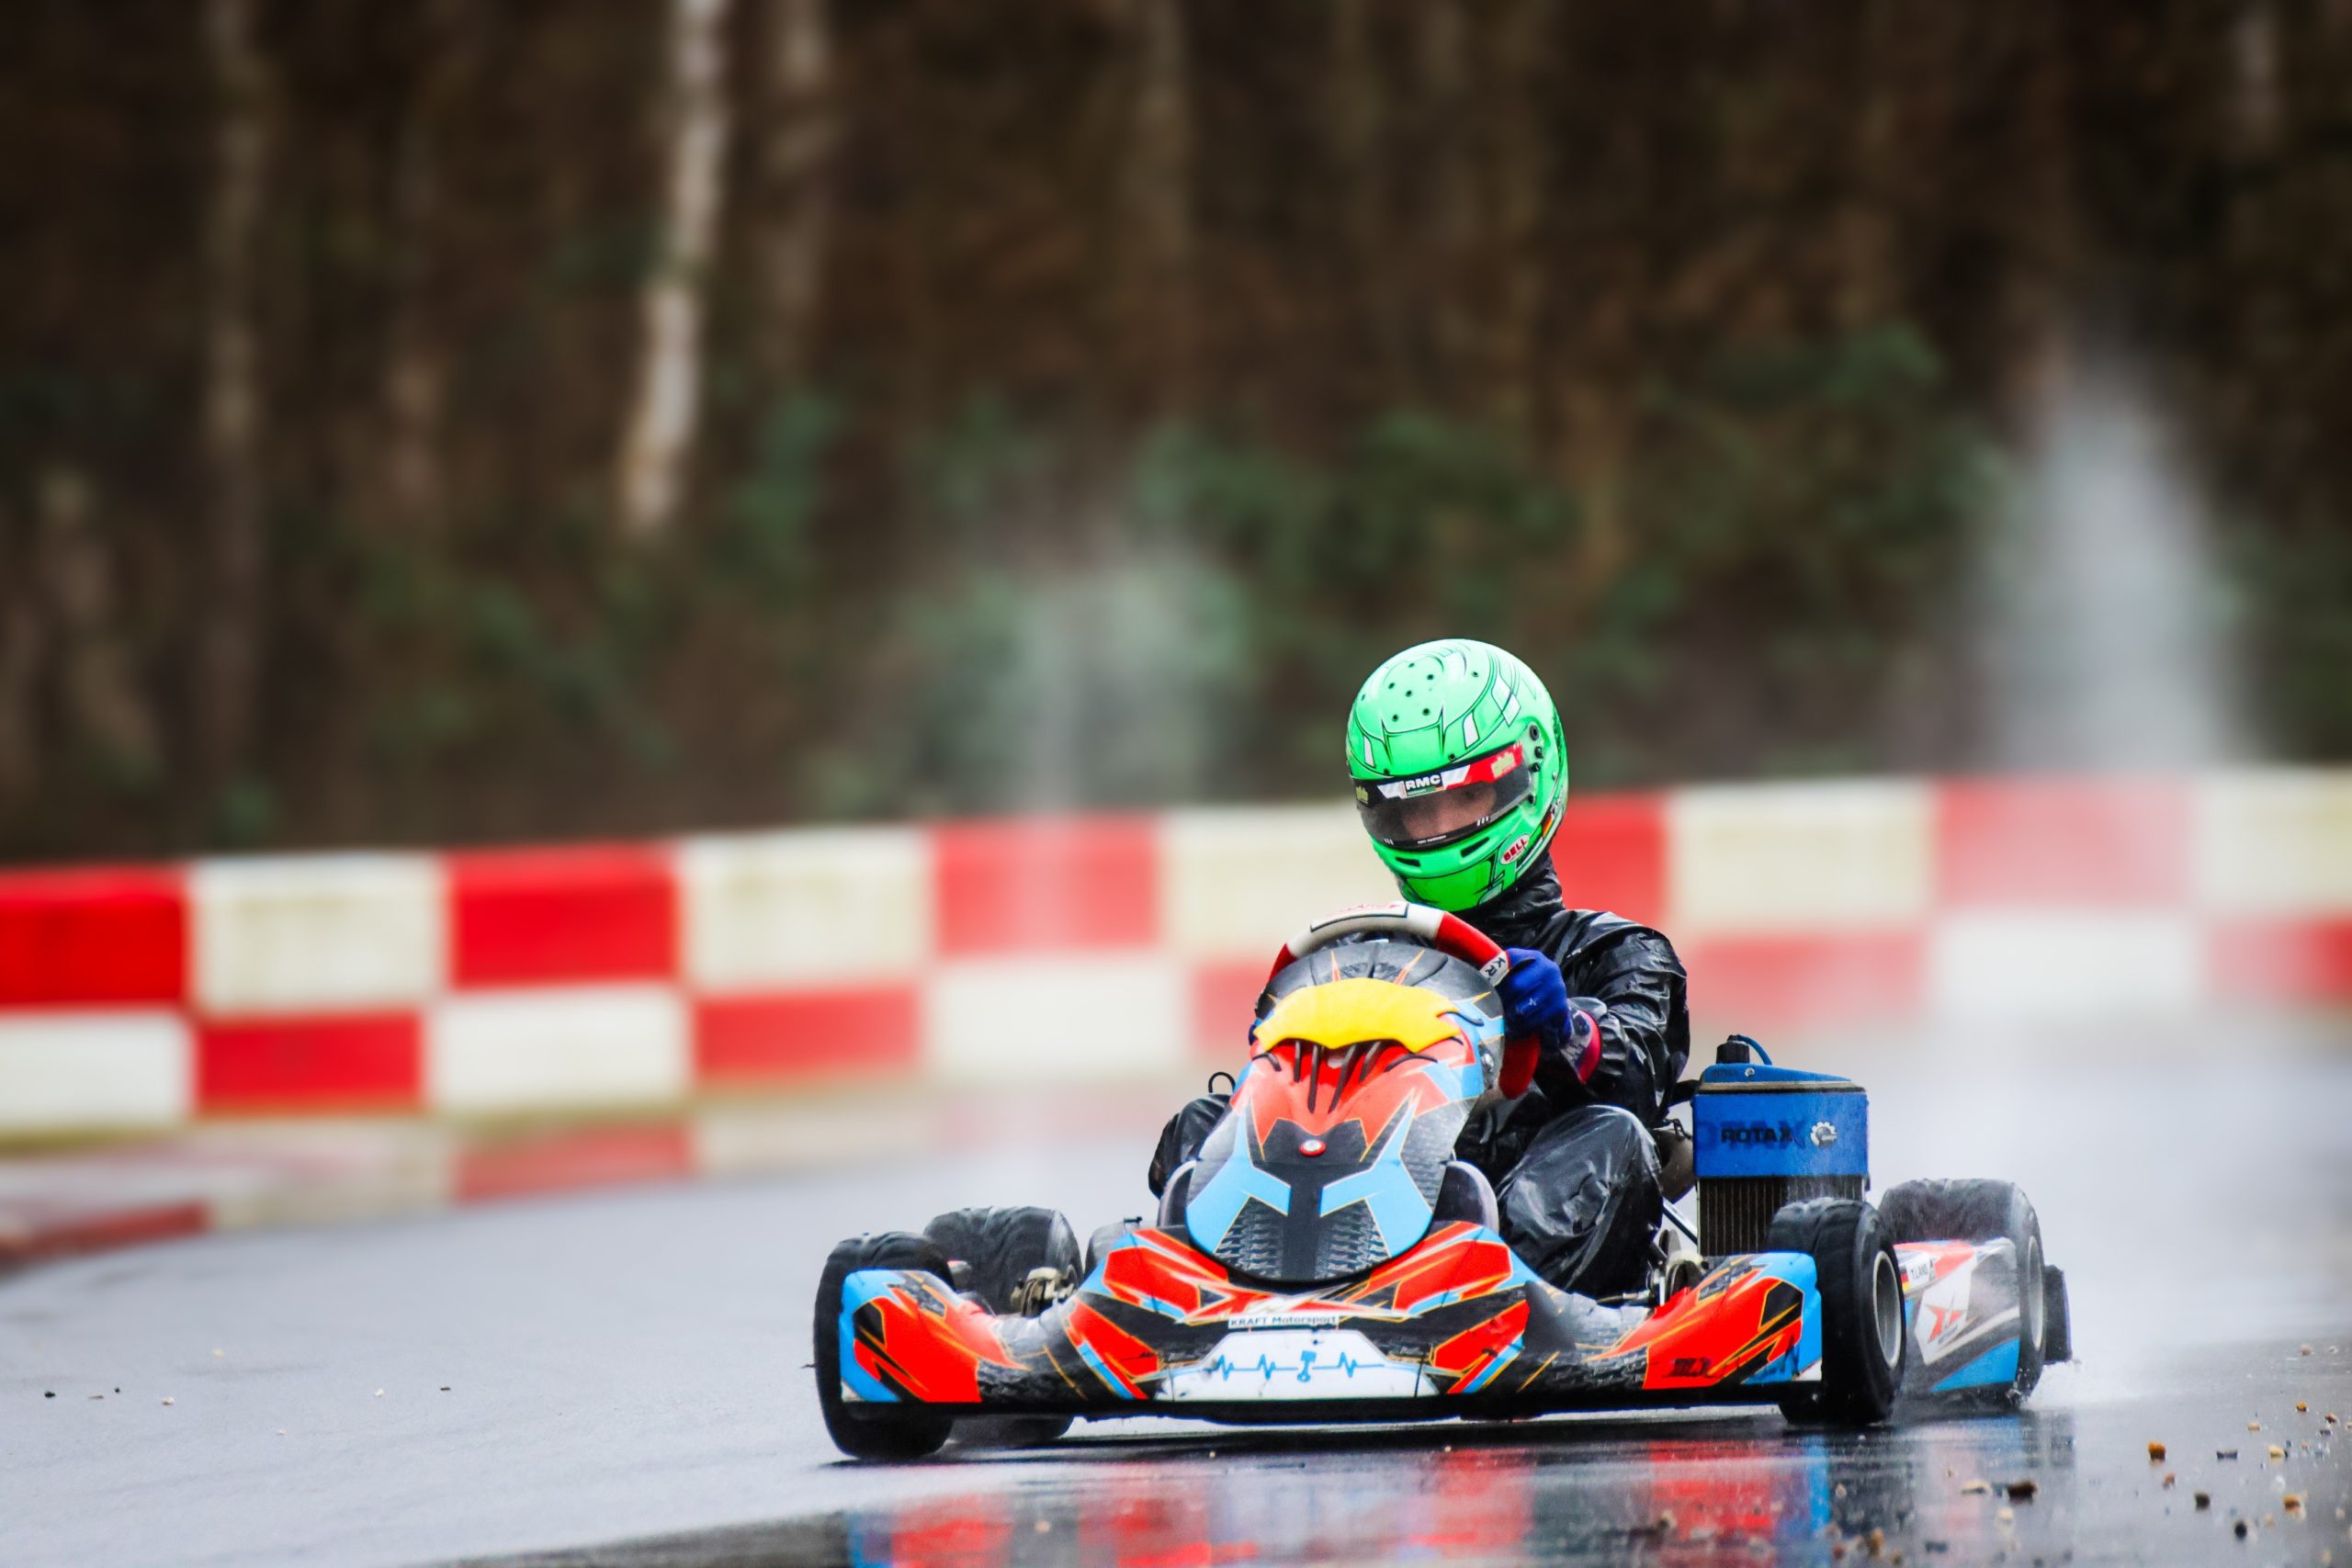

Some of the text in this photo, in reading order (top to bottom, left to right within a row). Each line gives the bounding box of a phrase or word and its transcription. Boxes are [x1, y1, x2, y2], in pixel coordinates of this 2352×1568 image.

[1406, 775, 1442, 790] RMC
[1504, 839, 1526, 862] BELL
[1485, 957, 1506, 980] KR
[1721, 1128, 1794, 1143] ROTAX
[1230, 1315, 1336, 1325] KRAFT Motorsport
